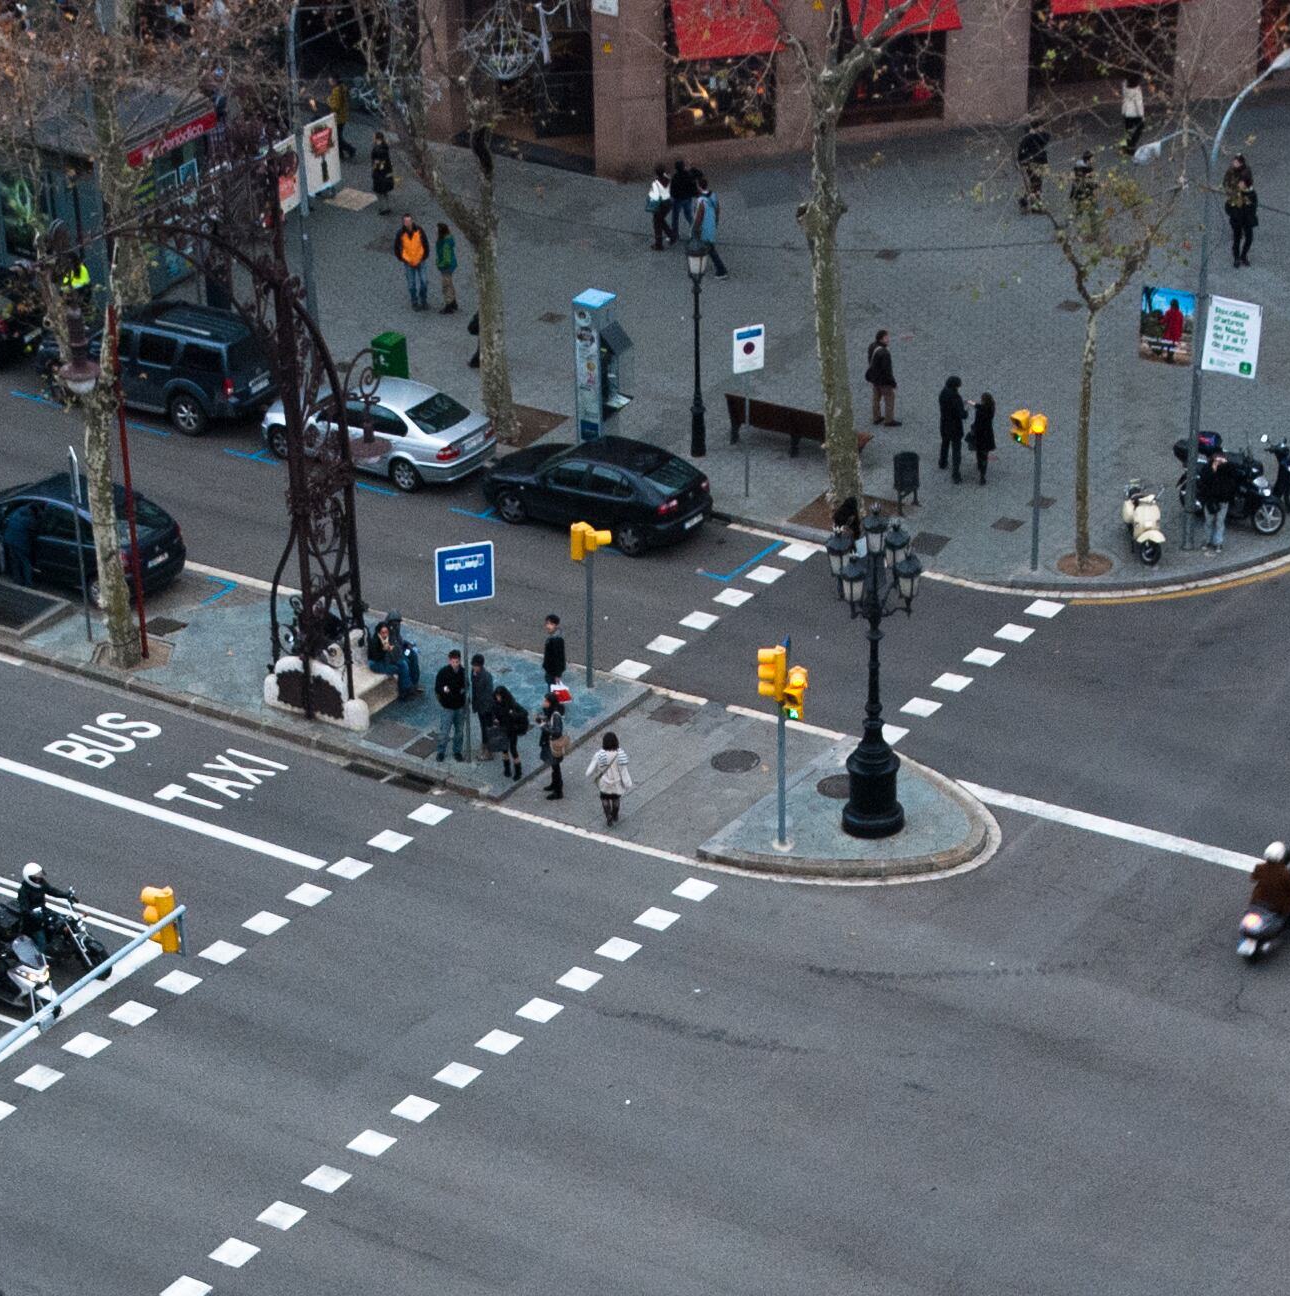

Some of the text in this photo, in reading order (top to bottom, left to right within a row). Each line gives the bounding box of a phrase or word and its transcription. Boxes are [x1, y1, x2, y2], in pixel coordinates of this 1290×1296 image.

[453, 579, 478, 594] taxi
[43, 711, 162, 770] BUS
[154, 748, 290, 810] TAXI
